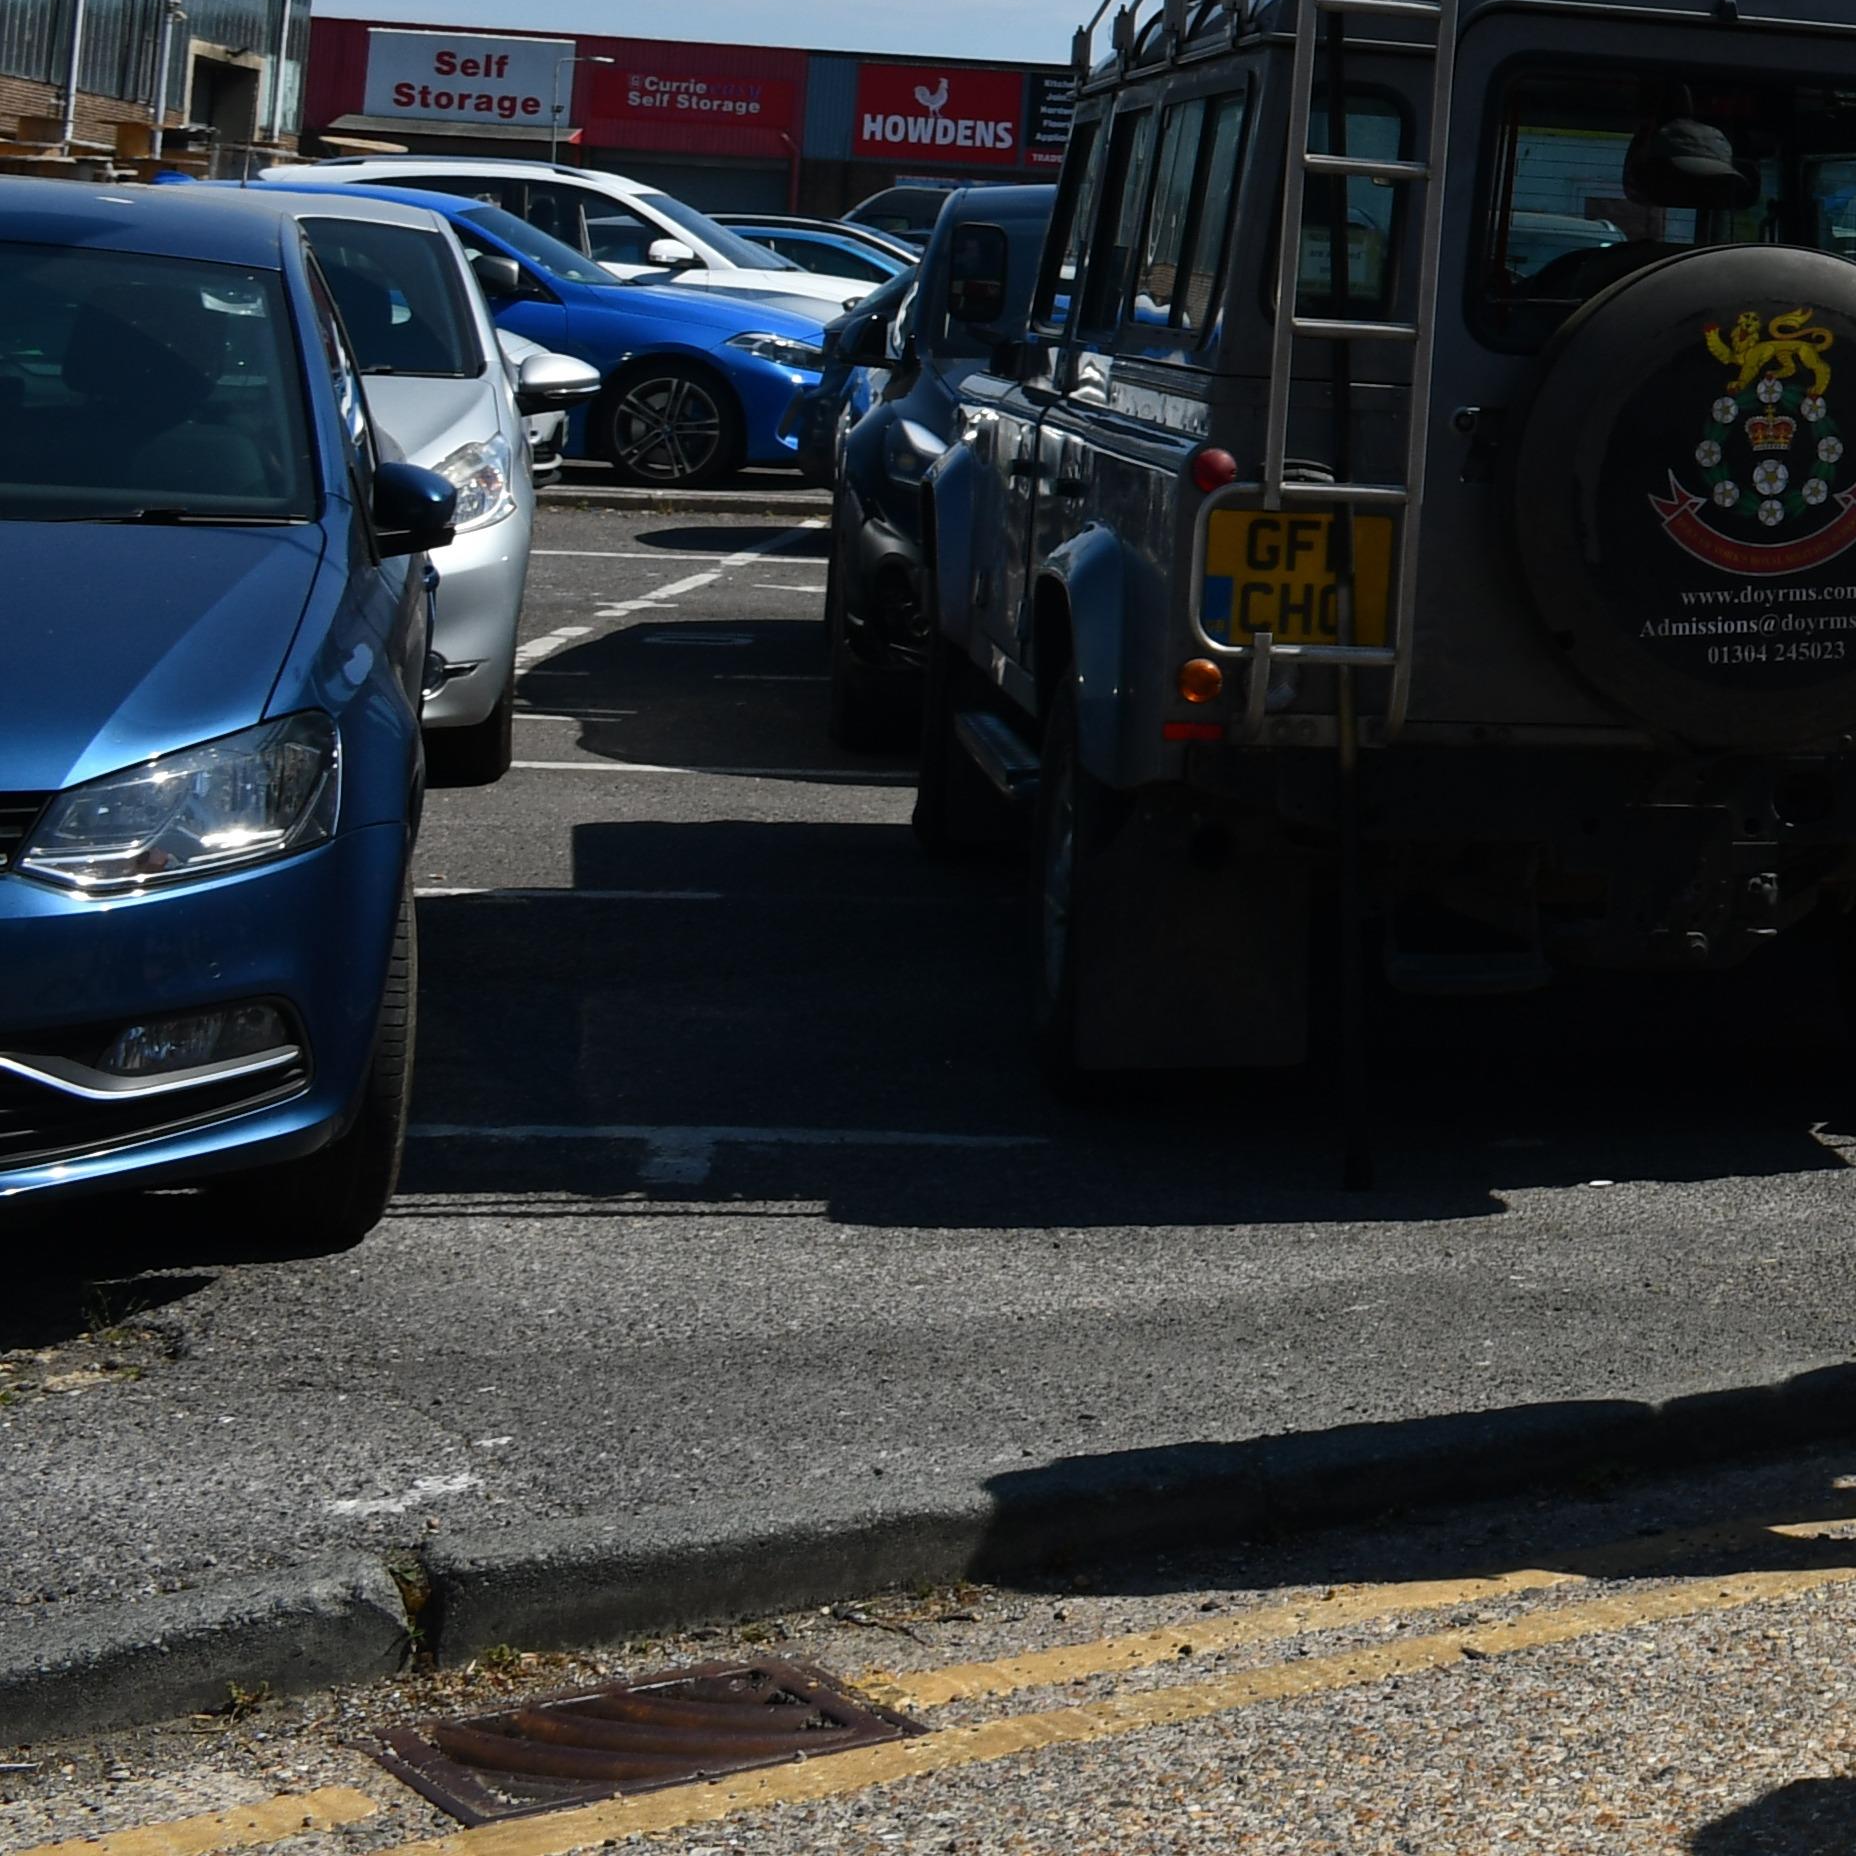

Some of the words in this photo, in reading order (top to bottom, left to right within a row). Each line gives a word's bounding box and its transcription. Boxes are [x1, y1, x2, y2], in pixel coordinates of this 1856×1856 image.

[434, 50, 511, 79] Self
[644, 75, 708, 95] Currie
[392, 81, 542, 120] Storage
[627, 91, 670, 108] Self
[676, 93, 761, 116] Storage
[861, 112, 1014, 150] HOWDENS
[1707, 644, 1770, 665] 01304
[1773, 640, 1847, 663] 245023
